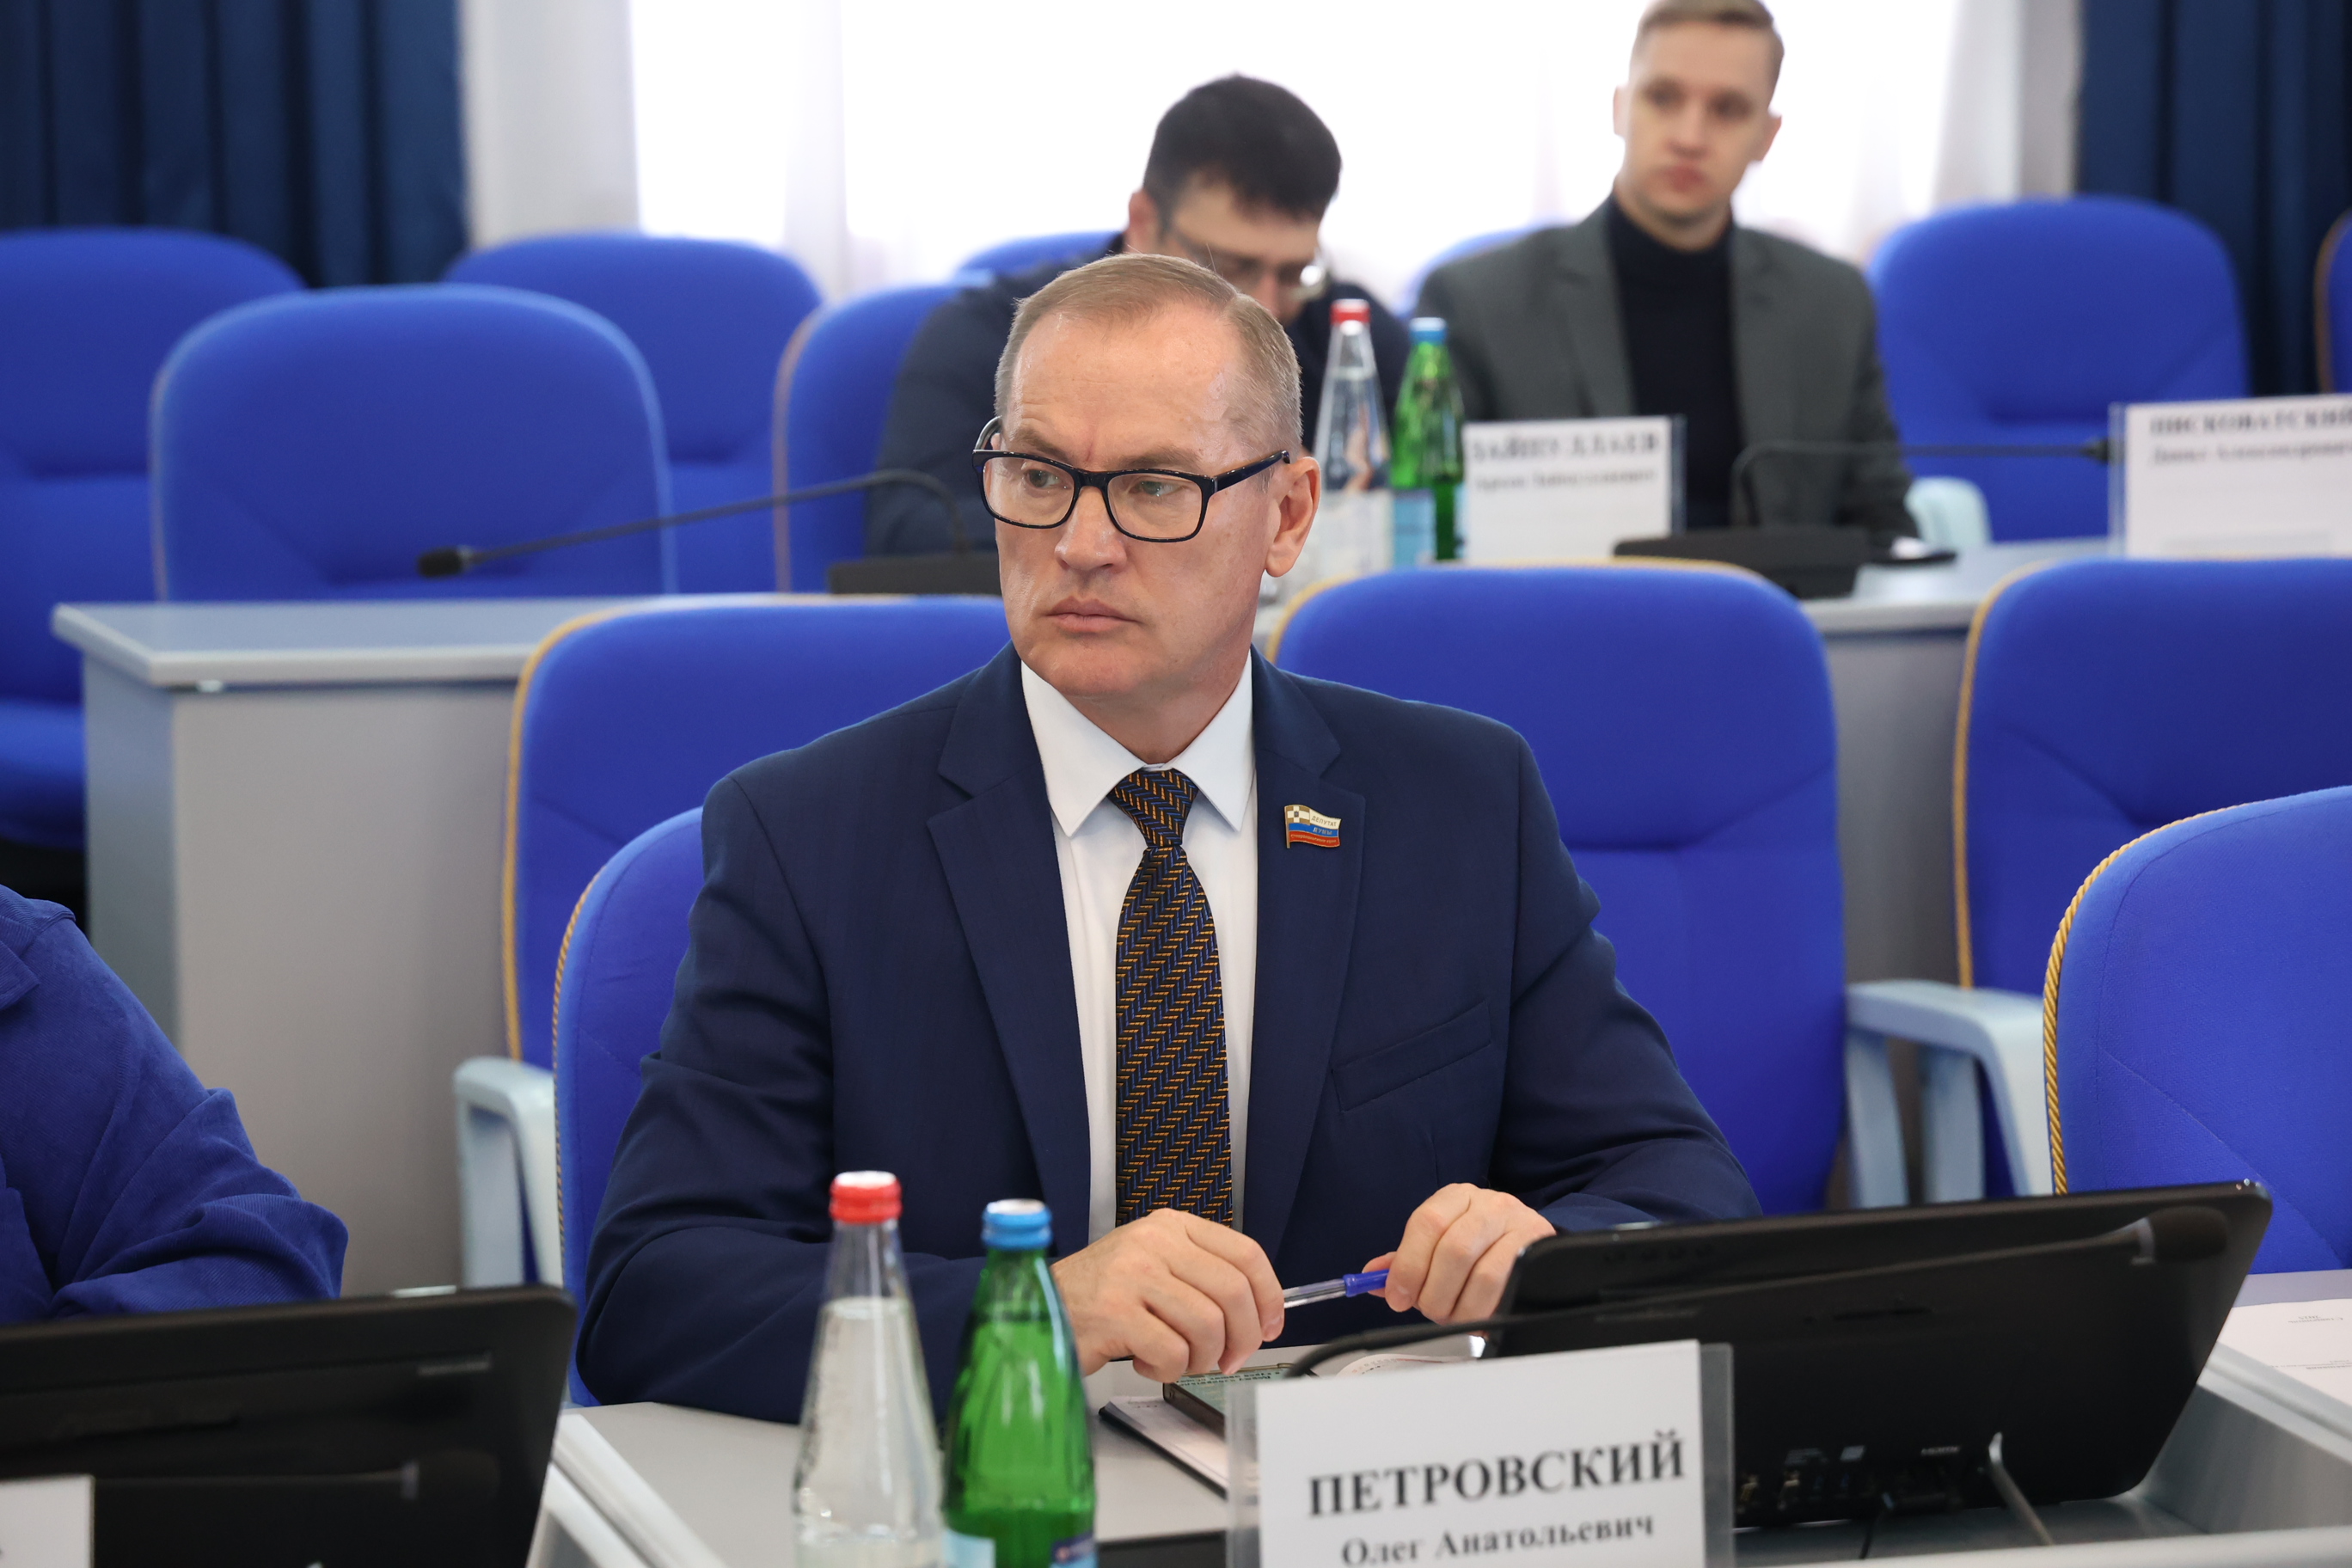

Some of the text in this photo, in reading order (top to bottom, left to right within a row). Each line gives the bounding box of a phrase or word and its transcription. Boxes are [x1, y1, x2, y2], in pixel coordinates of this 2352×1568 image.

[1311, 815, 1337, 827] ДЕПУТАТ
[1312, 827, 1332, 836] ДУМЫ
[1308, 1429, 1685, 1518] ПЕТРОВСКИЙ
[1341, 1514, 1656, 1568] Олег Анатольевич
